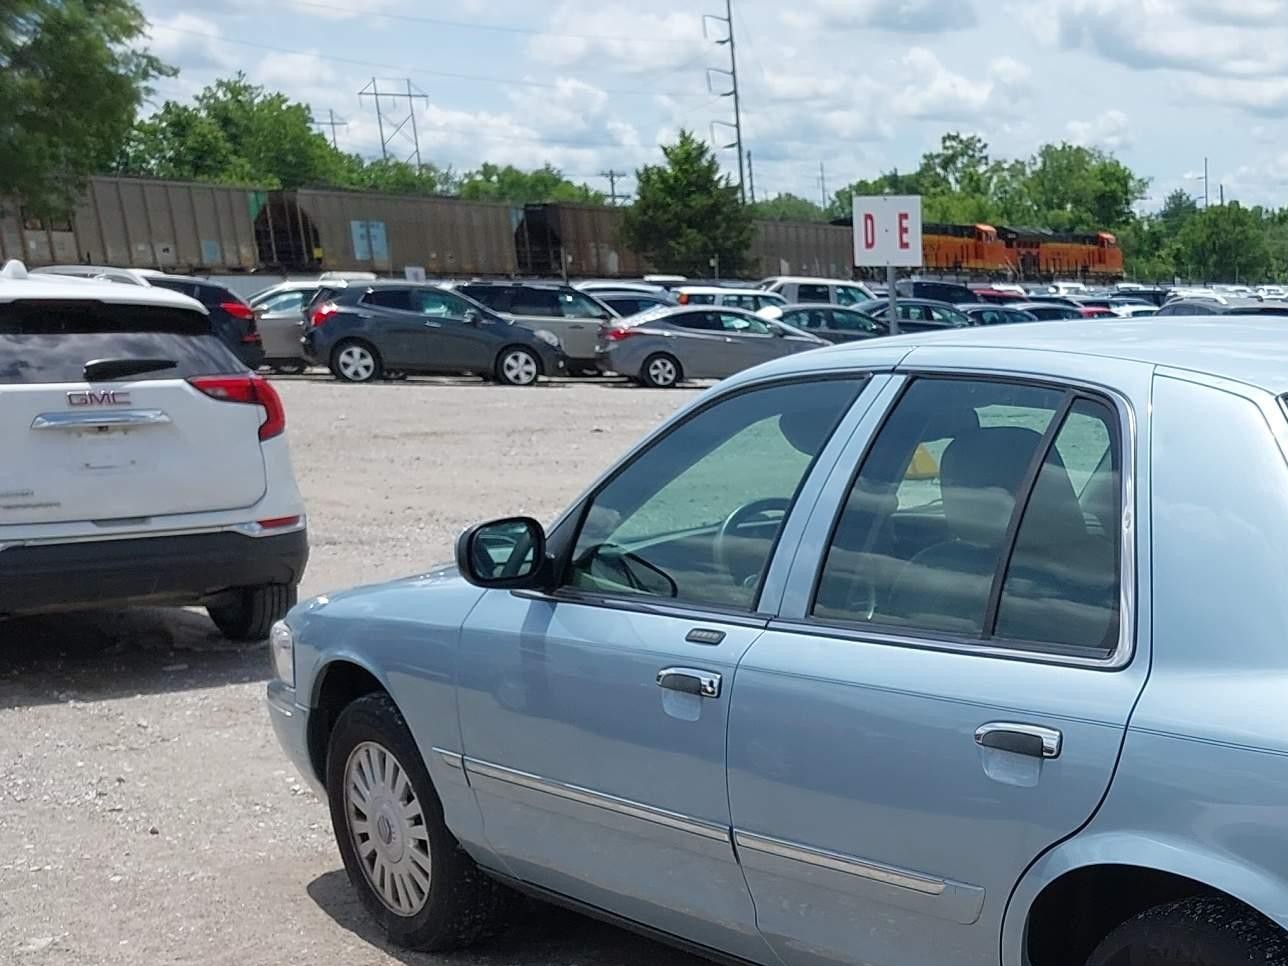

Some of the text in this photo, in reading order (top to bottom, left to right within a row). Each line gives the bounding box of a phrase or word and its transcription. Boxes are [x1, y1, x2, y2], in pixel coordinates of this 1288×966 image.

[863, 212, 910, 250] D E
[66, 390, 132, 406] GMC
